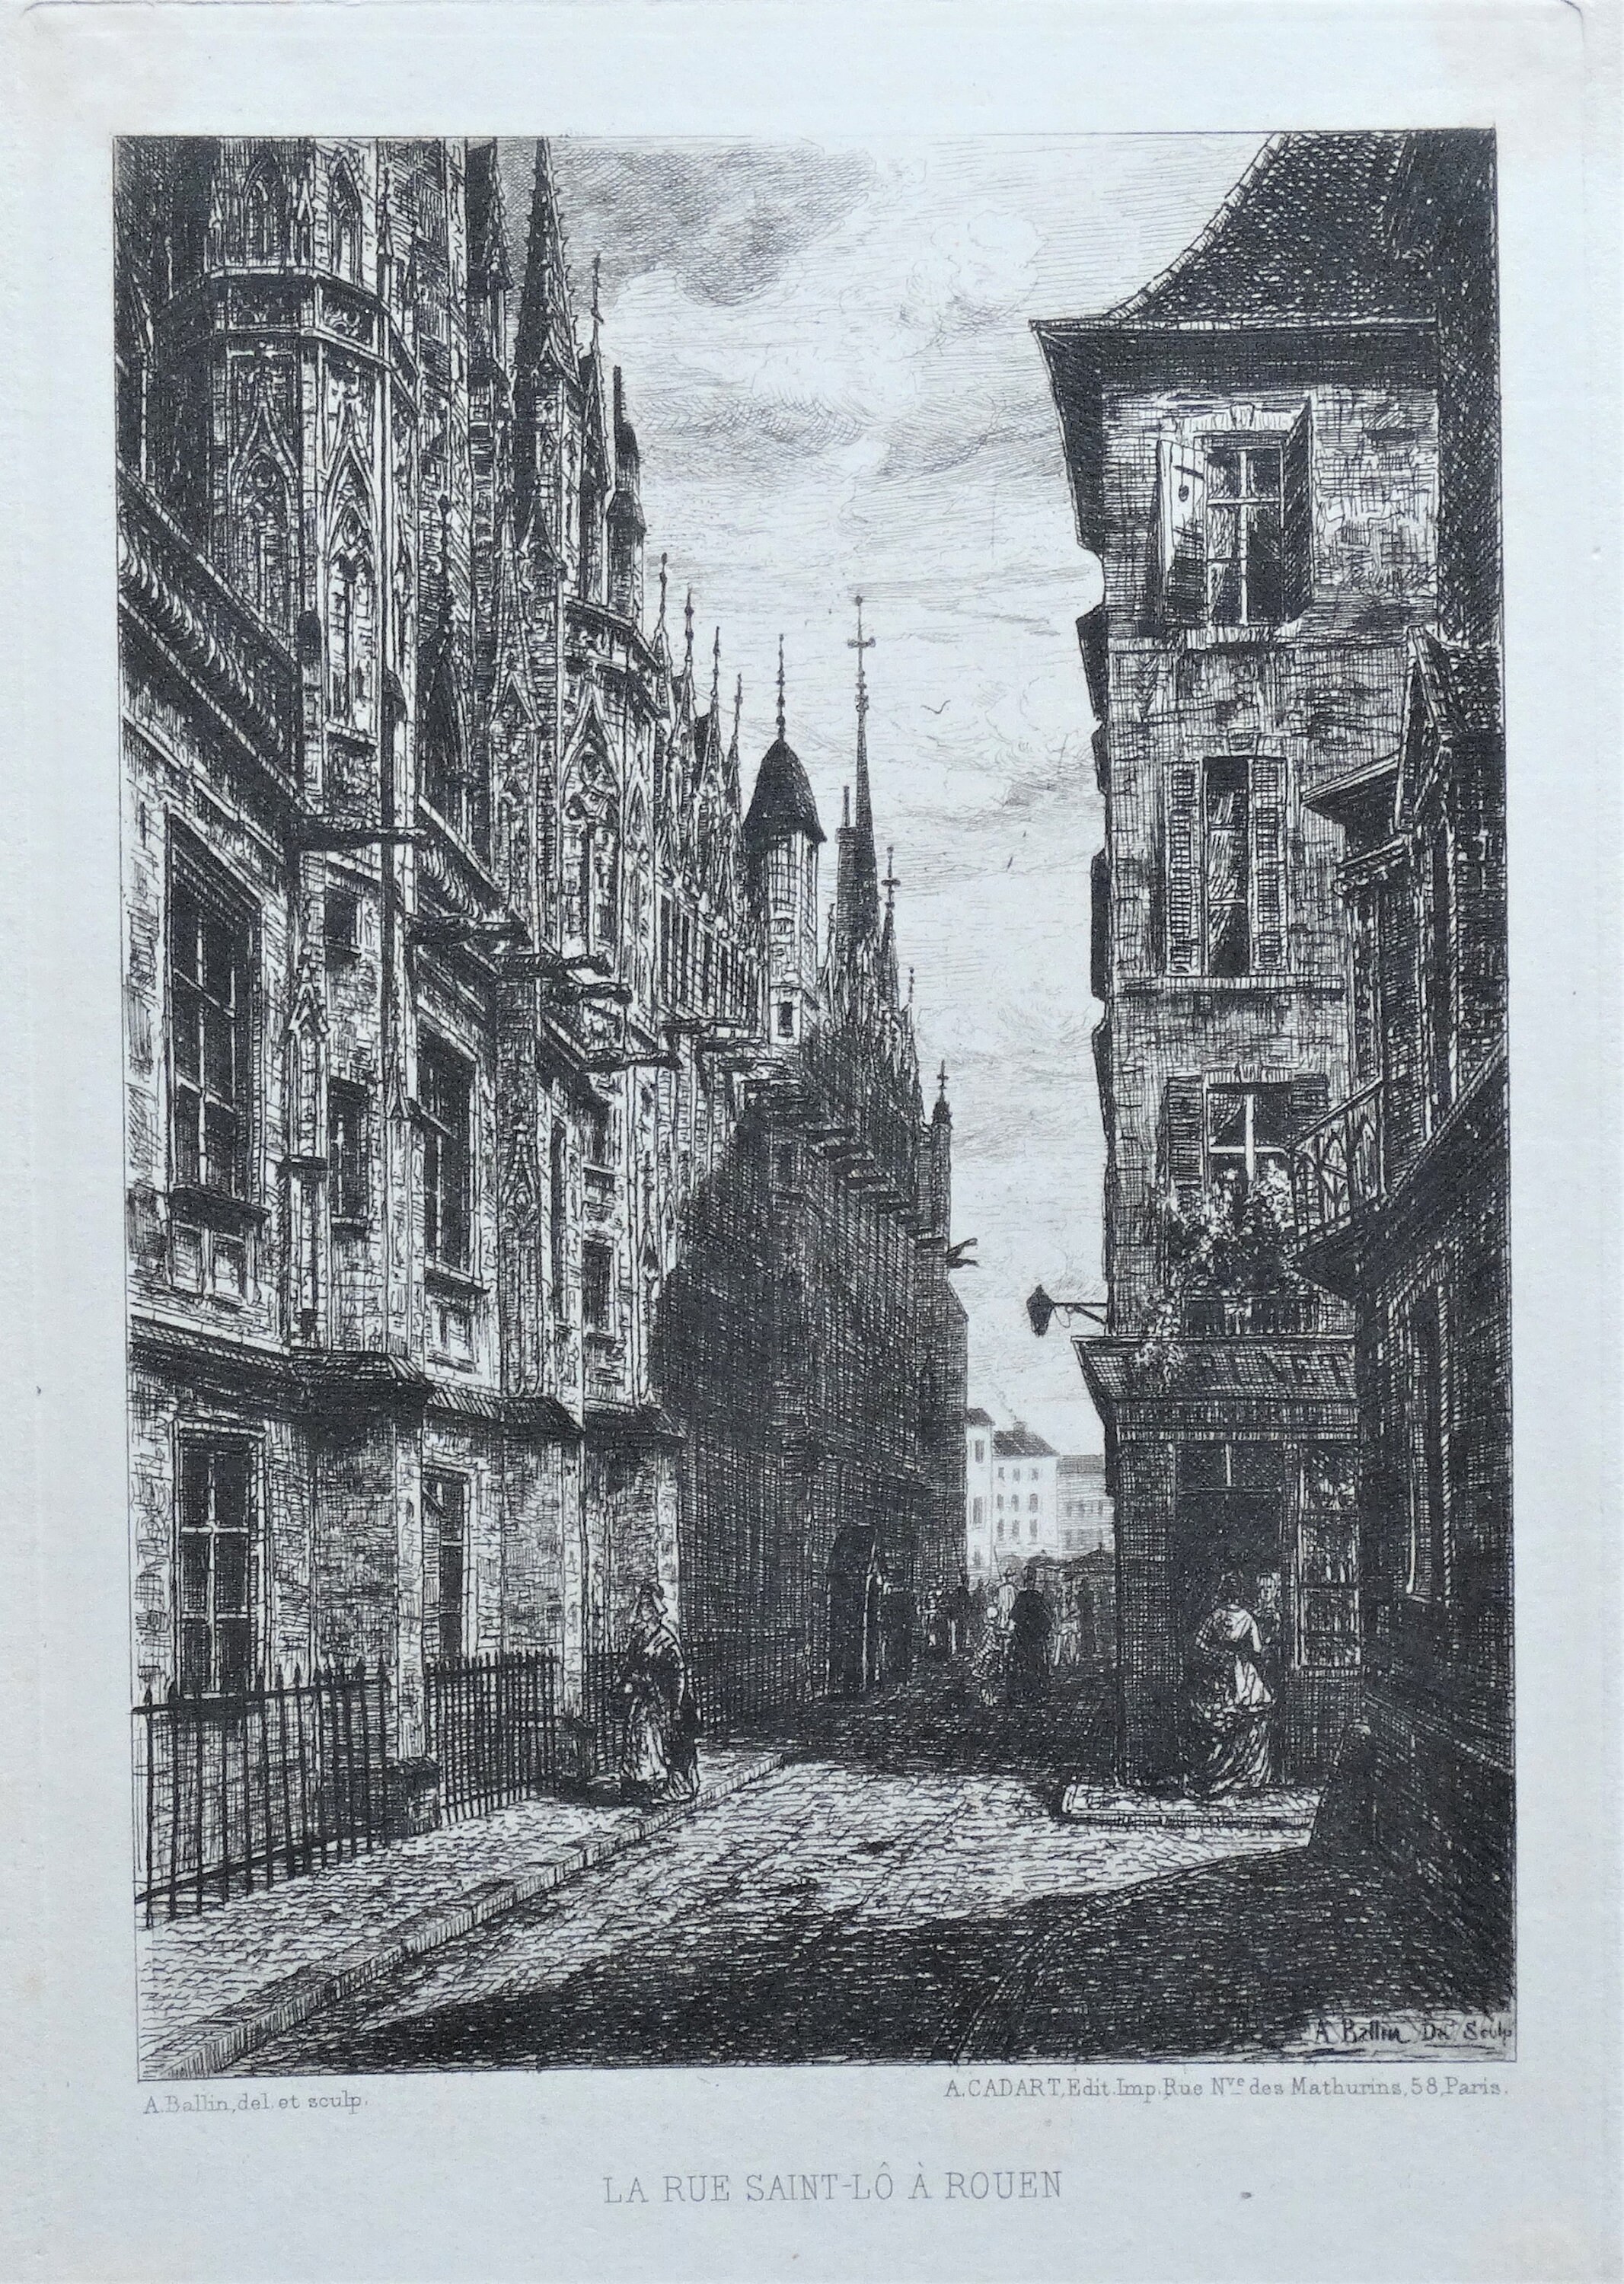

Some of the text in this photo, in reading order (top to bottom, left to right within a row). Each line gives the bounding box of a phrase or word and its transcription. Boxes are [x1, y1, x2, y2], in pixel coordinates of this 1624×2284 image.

[1249, 2076, 1284, 2095] des
[603, 2161, 1063, 2204] LA RUE SAINT-LÔ À ROUEN
